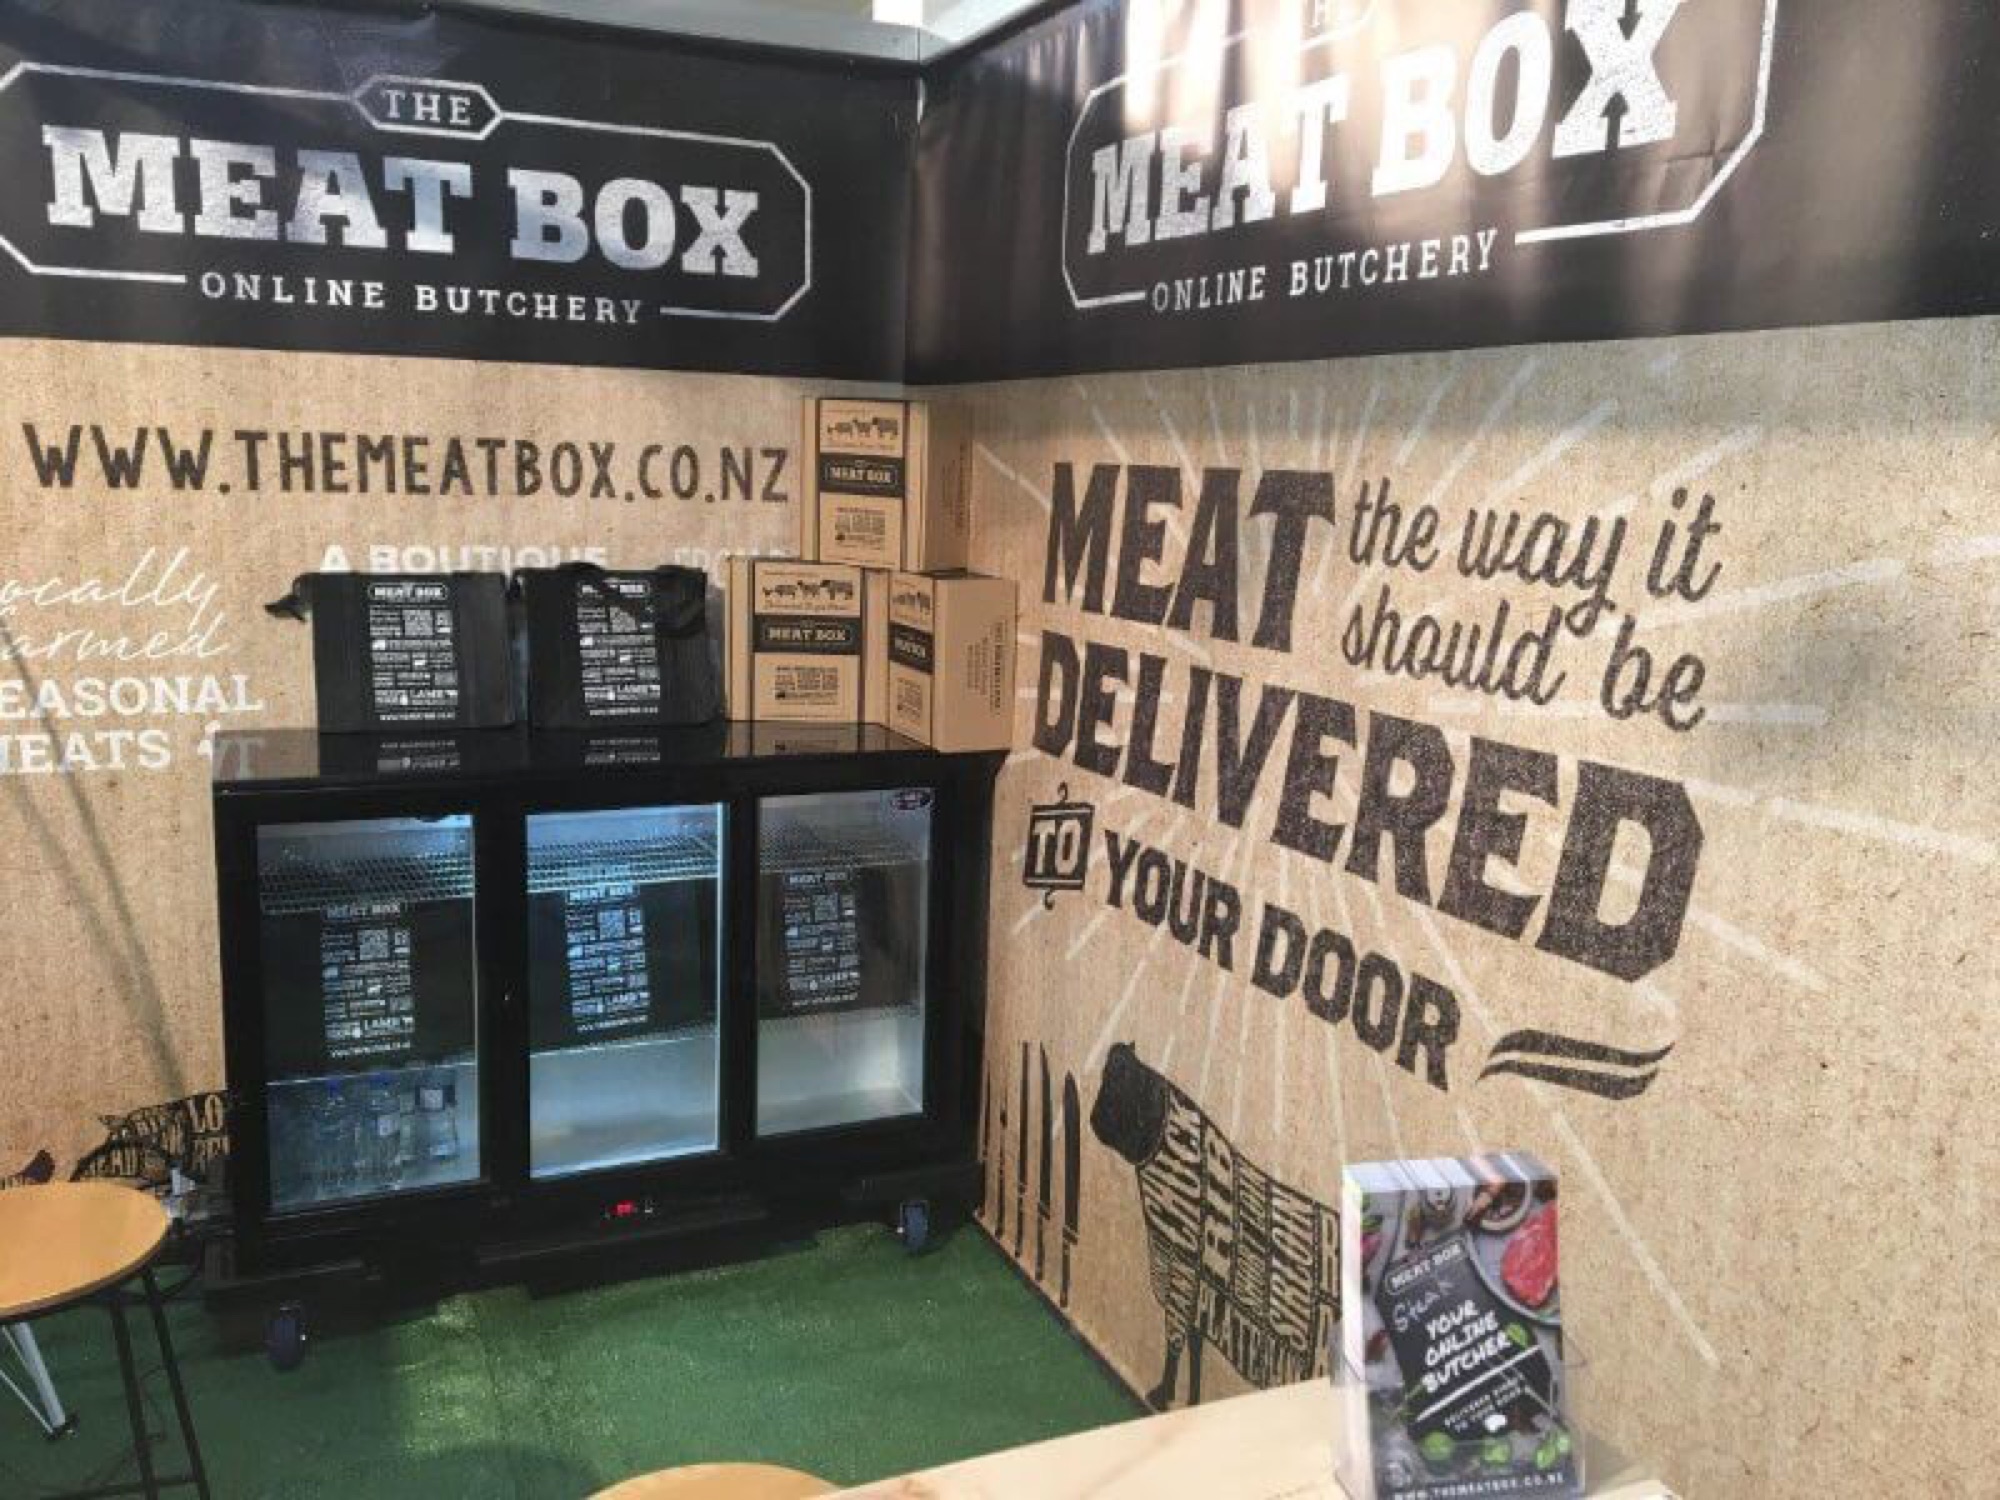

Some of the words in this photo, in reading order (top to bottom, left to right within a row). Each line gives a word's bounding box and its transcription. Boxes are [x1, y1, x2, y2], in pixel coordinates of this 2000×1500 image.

[380, 89, 472, 128] THE
[1086, 78, 1349, 256] MEAT
[1370, 0, 1679, 200] BOX
[41, 124, 472, 254] MEAT
[506, 167, 760, 278] BOX
[201, 271, 387, 310] ONLINE
[415, 285, 643, 326] BUTCHERY
[1152, 263, 1267, 314] ONLINE
[1289, 228, 1499, 297] BUTCHERY
[22, 423, 790, 503] WWW.THEMEATBOX.CO.NZ
[0, 547, 219, 634] ocally
[1042, 462, 1336, 653] MEAT
[1348, 477, 1440, 569] the
[1457, 504, 1627, 636] way
[1646, 487, 1723, 600] it
[0, 612, 231, 661] armed
[769, 626, 813, 641] MEAT
[815, 629, 846, 641] BOX
[1341, 585, 1568, 706] should
[1600, 614, 1707, 732] be
[0, 674, 264, 719] EASONAL
[1032, 630, 1704, 984] DELIVERED
[1031, 819, 1084, 876] TO
[1103, 829, 1242, 973] YOUR
[1250, 903, 1462, 1092] DOOR
[1424, 1299, 1480, 1341] YOUR
[1424, 1309, 1500, 1367] ONLINE
[1421, 1331, 1513, 1393] BUTCHER
